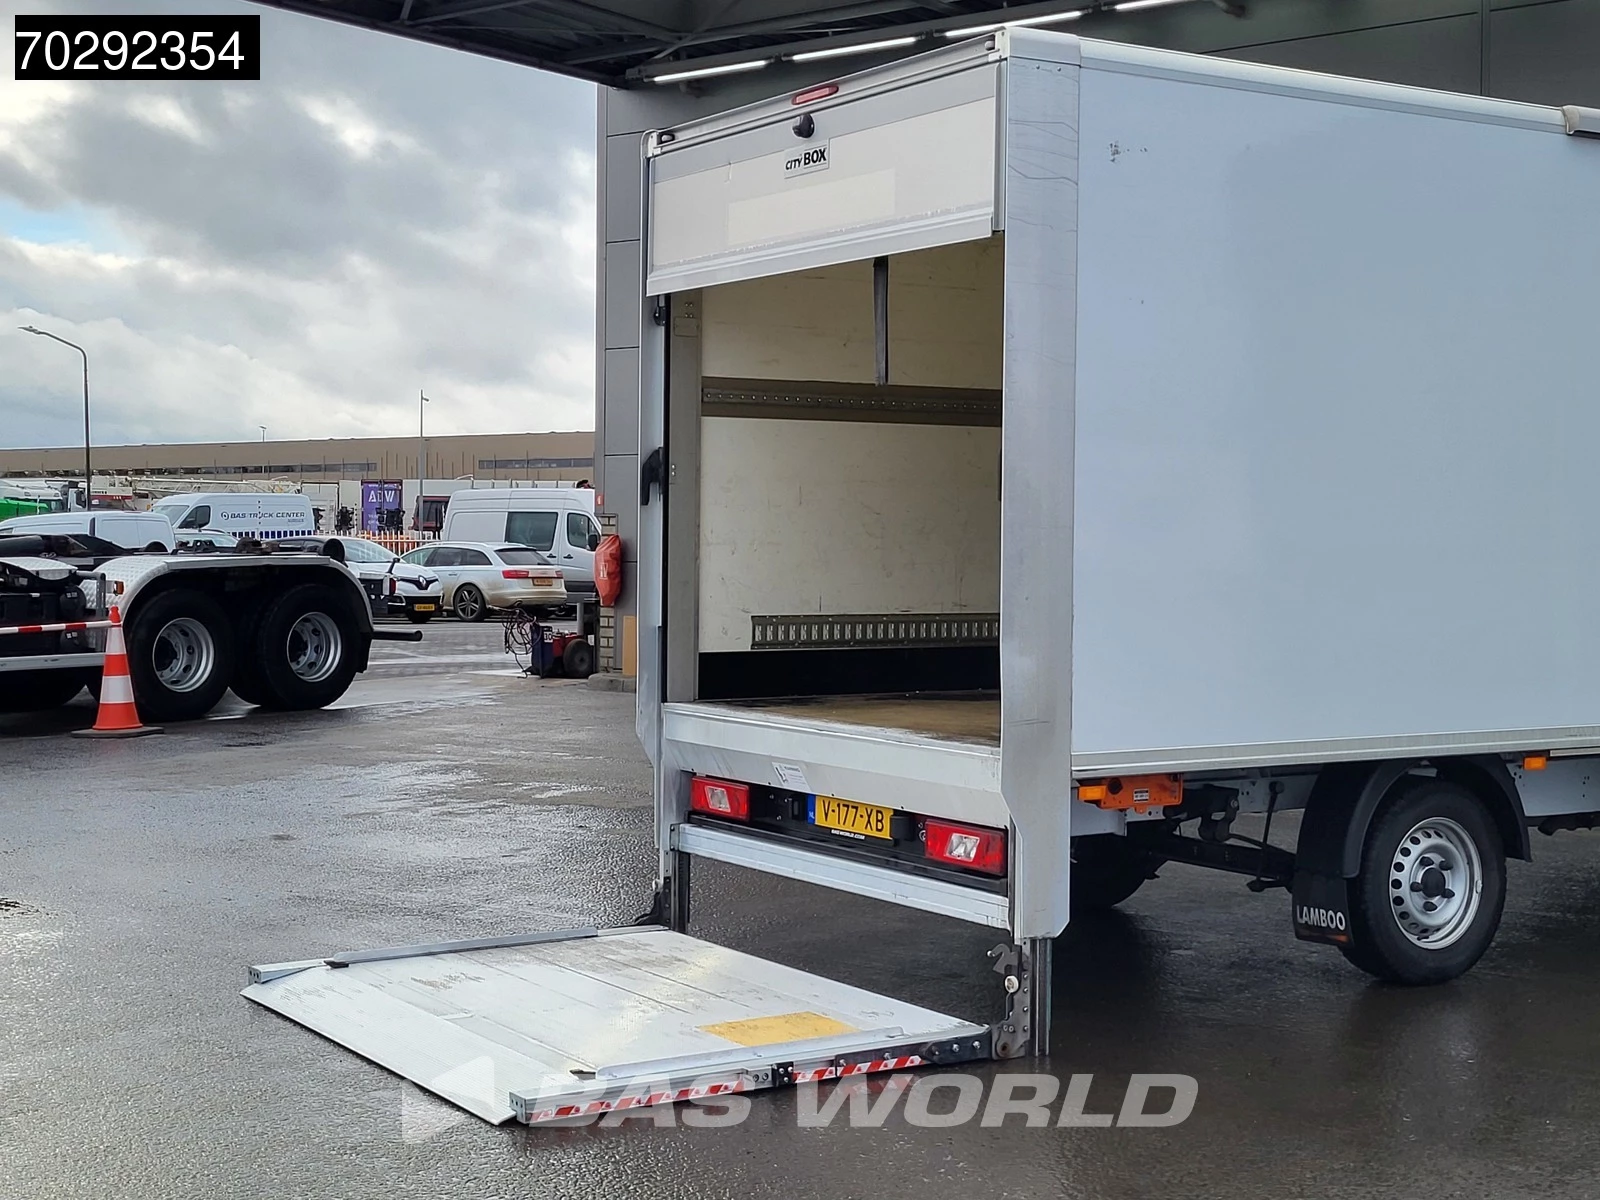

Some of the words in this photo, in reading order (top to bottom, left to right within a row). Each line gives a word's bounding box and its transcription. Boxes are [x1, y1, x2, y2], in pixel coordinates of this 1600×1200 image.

[785, 157, 803, 170] CITY
[803, 147, 828, 167] BOX
[275, 511, 305, 519] CENTER
[822, 799, 885, 833] V-177-XB
[1296, 905, 1346, 931] LAMBOO
